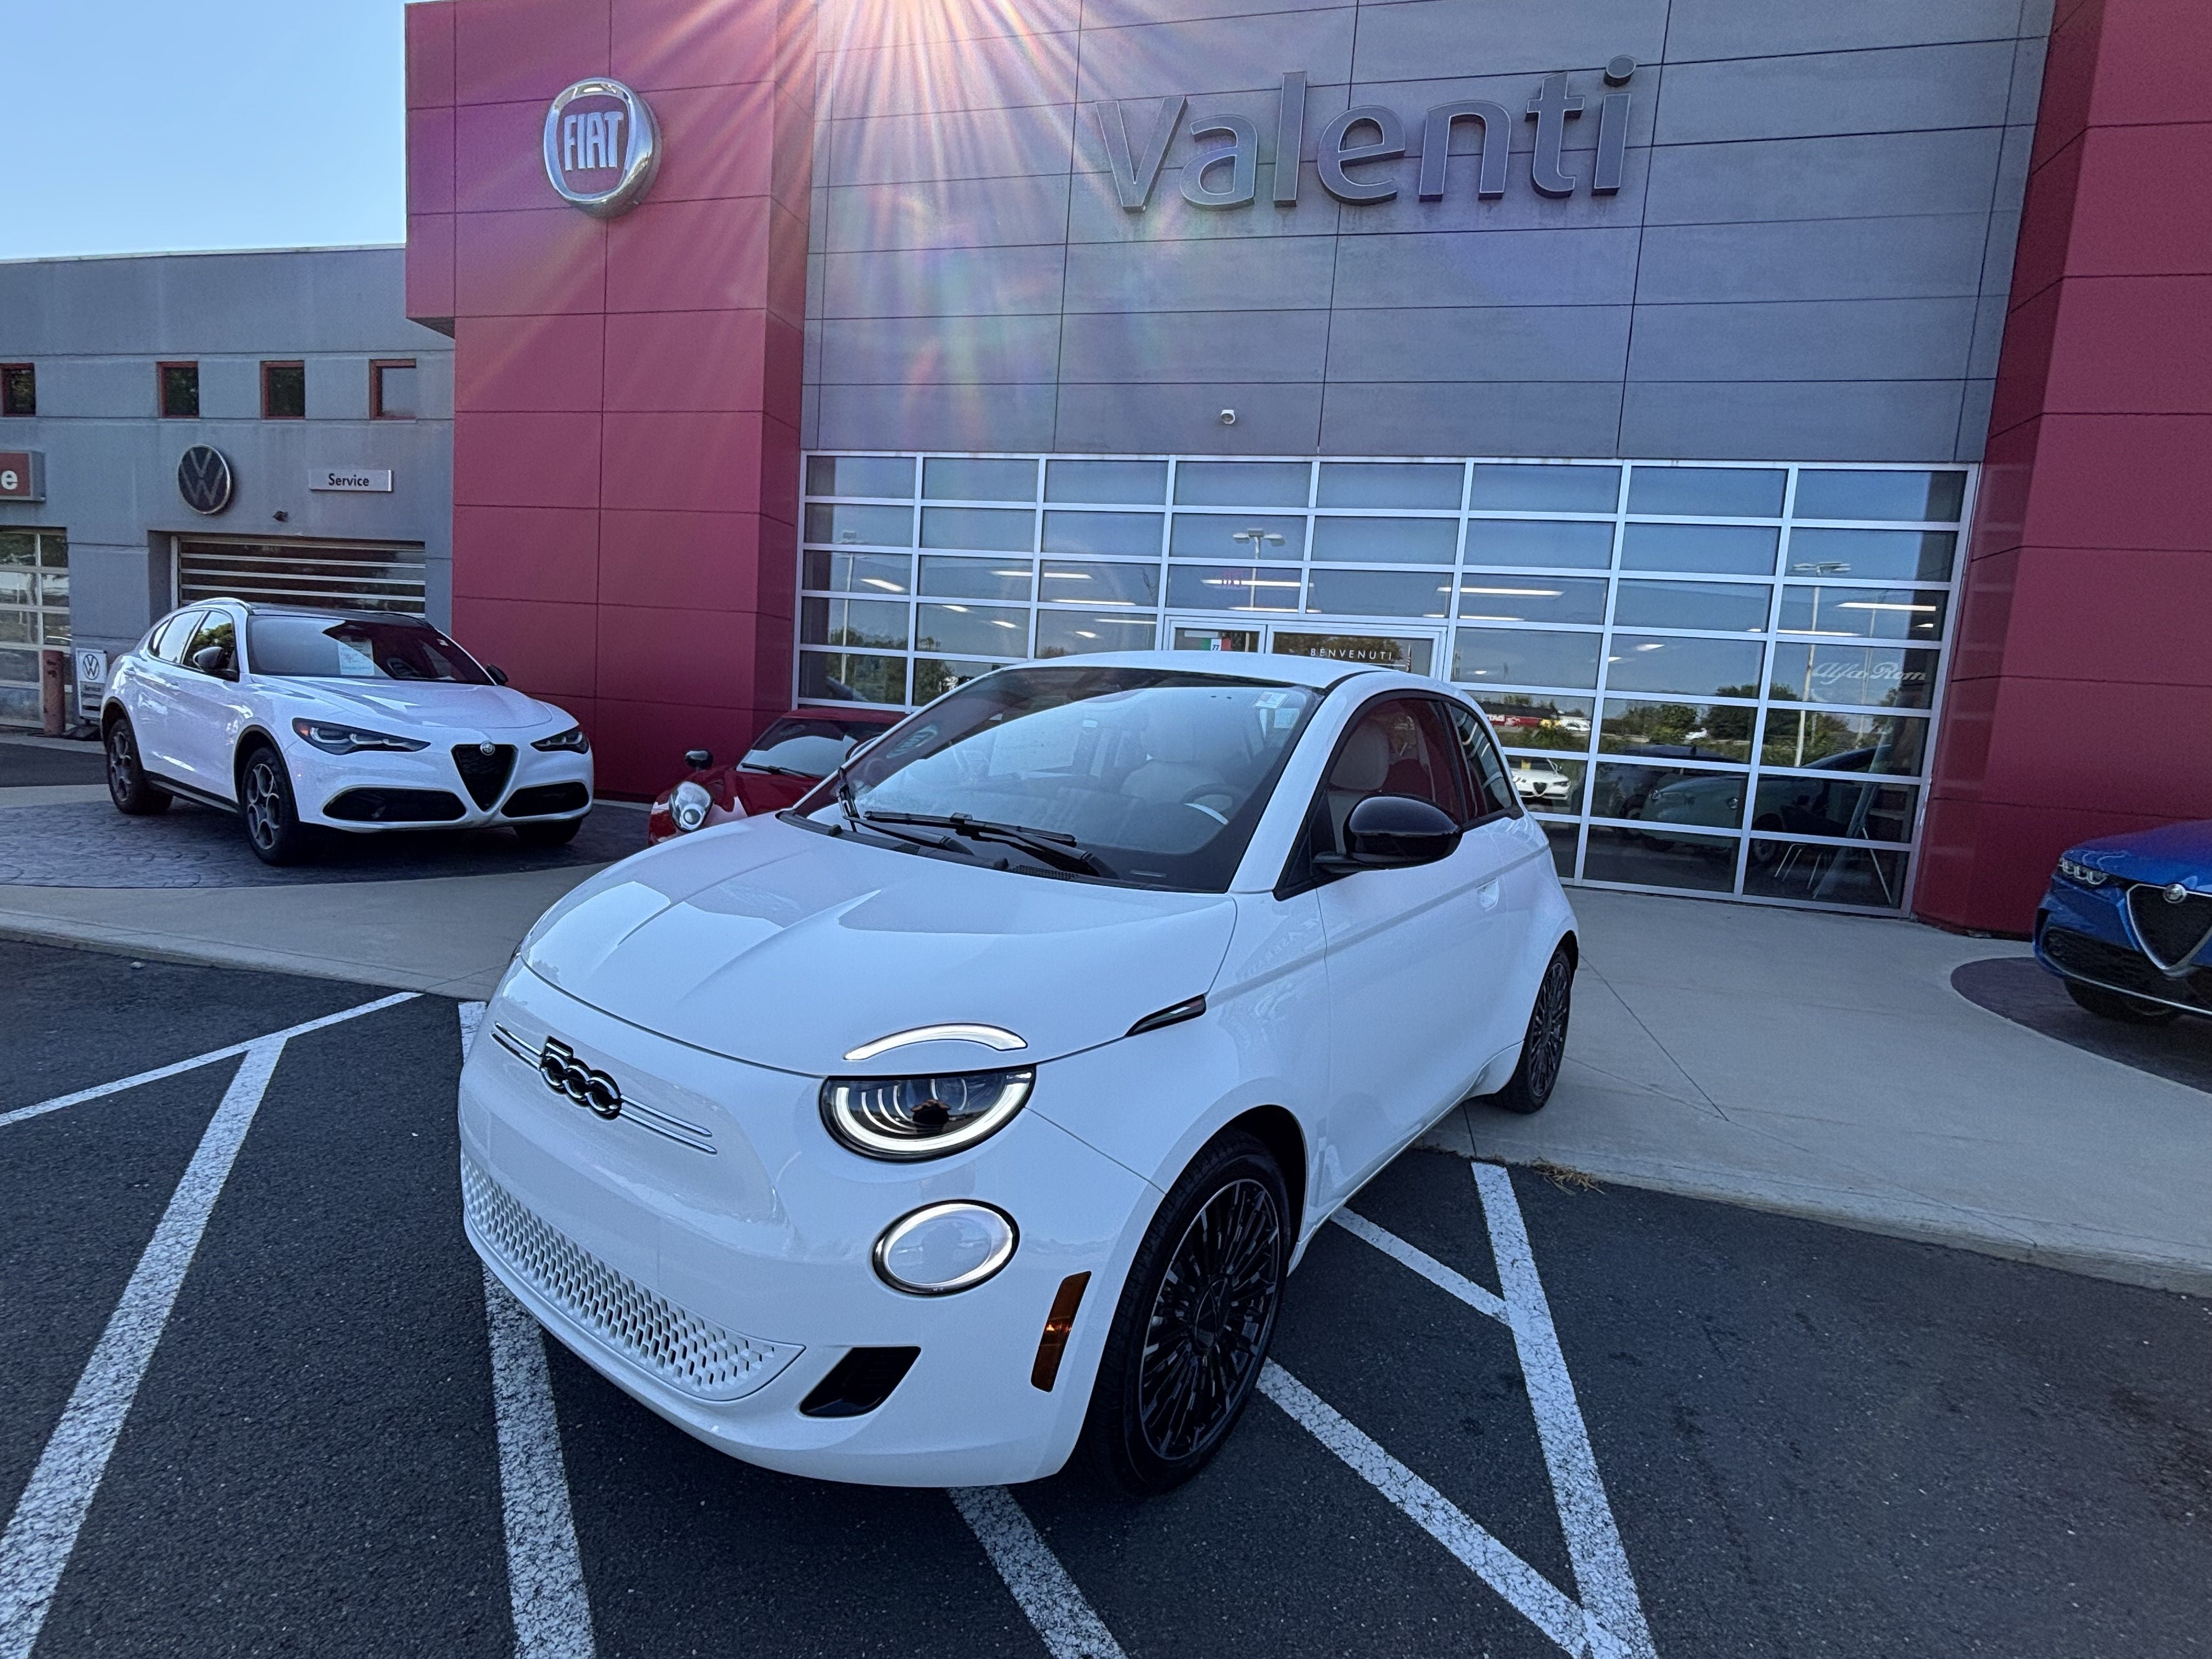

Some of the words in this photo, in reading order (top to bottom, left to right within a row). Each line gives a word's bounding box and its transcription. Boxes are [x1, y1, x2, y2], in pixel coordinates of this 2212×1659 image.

[563, 110, 624, 171] FIAT
[1096, 55, 1637, 212] Valenti
[328, 473, 369, 487] Service
[1310, 648, 1392, 661] BENVENUTI
[1811, 662, 1866, 685] Alfa
[540, 1035, 622, 1121] 500
